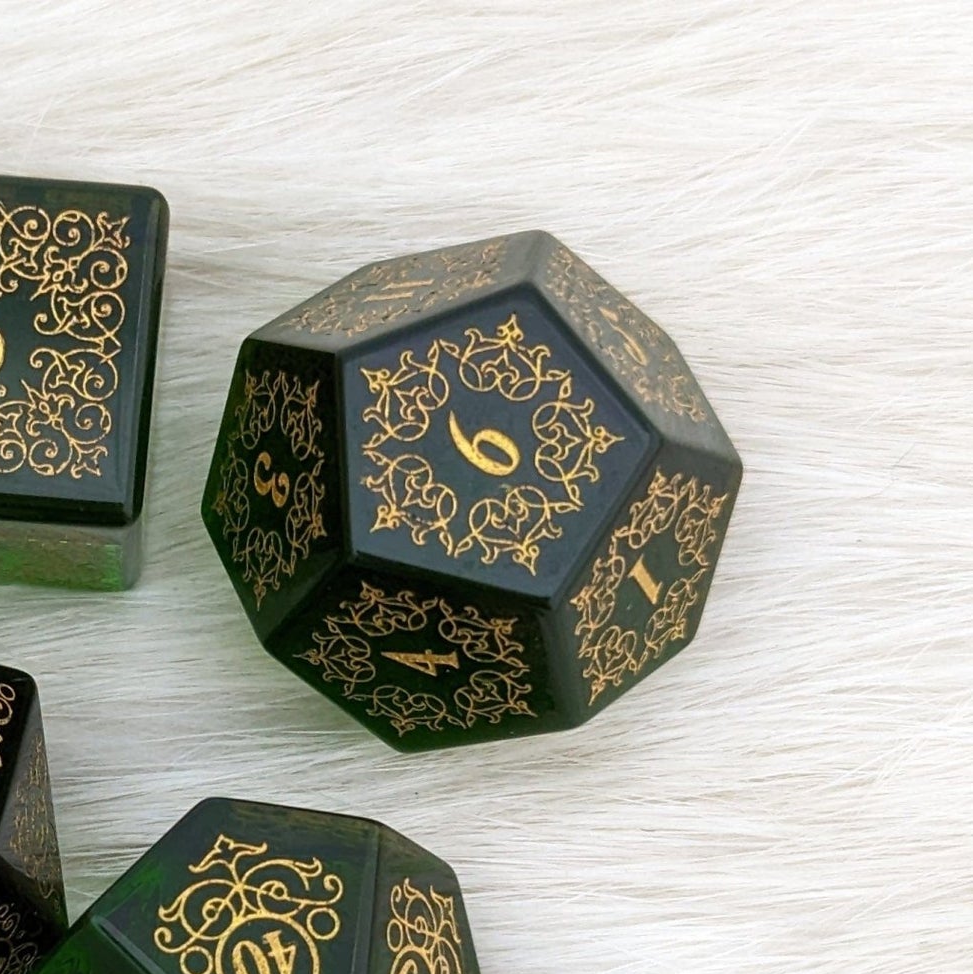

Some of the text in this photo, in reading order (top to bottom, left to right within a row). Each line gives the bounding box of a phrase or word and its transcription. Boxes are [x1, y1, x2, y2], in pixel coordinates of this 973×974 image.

[448, 411, 520, 475] 6
[254, 452, 289, 507] 3
[627, 554, 663, 605] 1
[380, 648, 460, 676] 4
